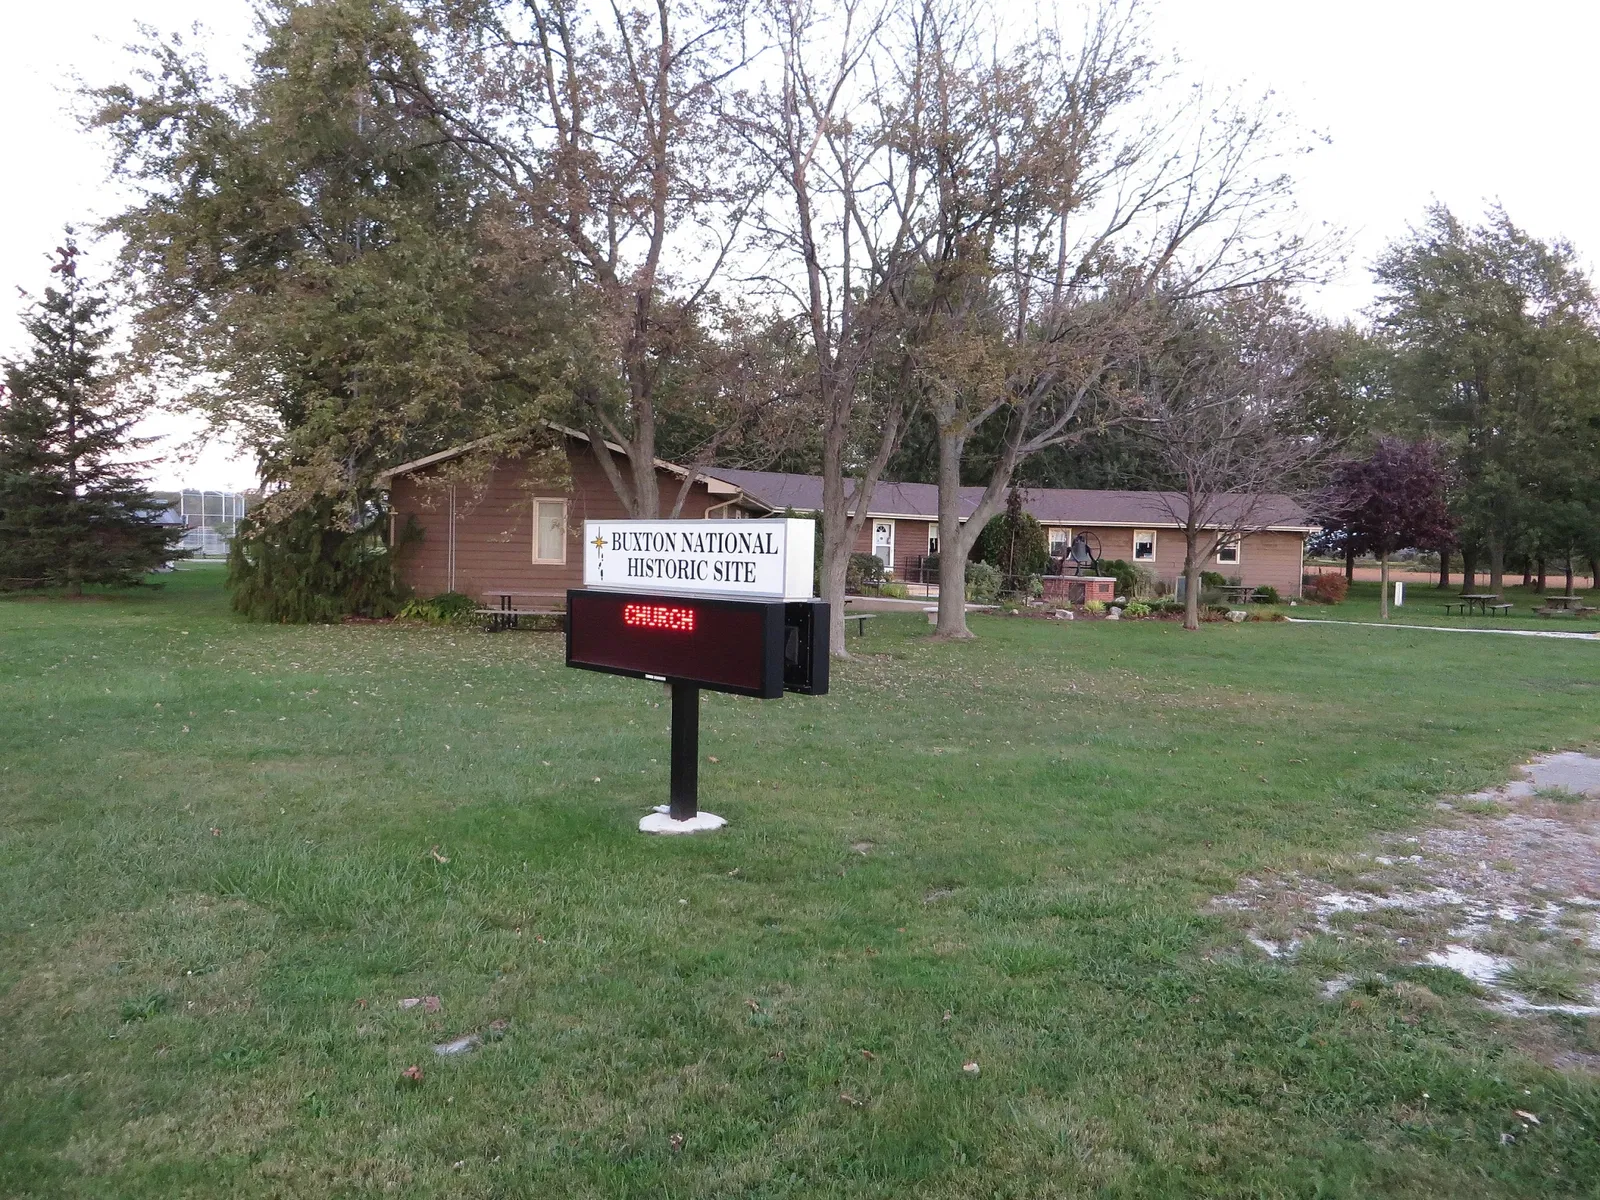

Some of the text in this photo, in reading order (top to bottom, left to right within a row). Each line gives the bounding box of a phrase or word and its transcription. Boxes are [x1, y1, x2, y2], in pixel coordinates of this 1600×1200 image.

[612, 532, 779, 555] BUXTON NATIONAL
[627, 557, 756, 583] HISTORIC SITE
[624, 604, 694, 631] CHURCH
